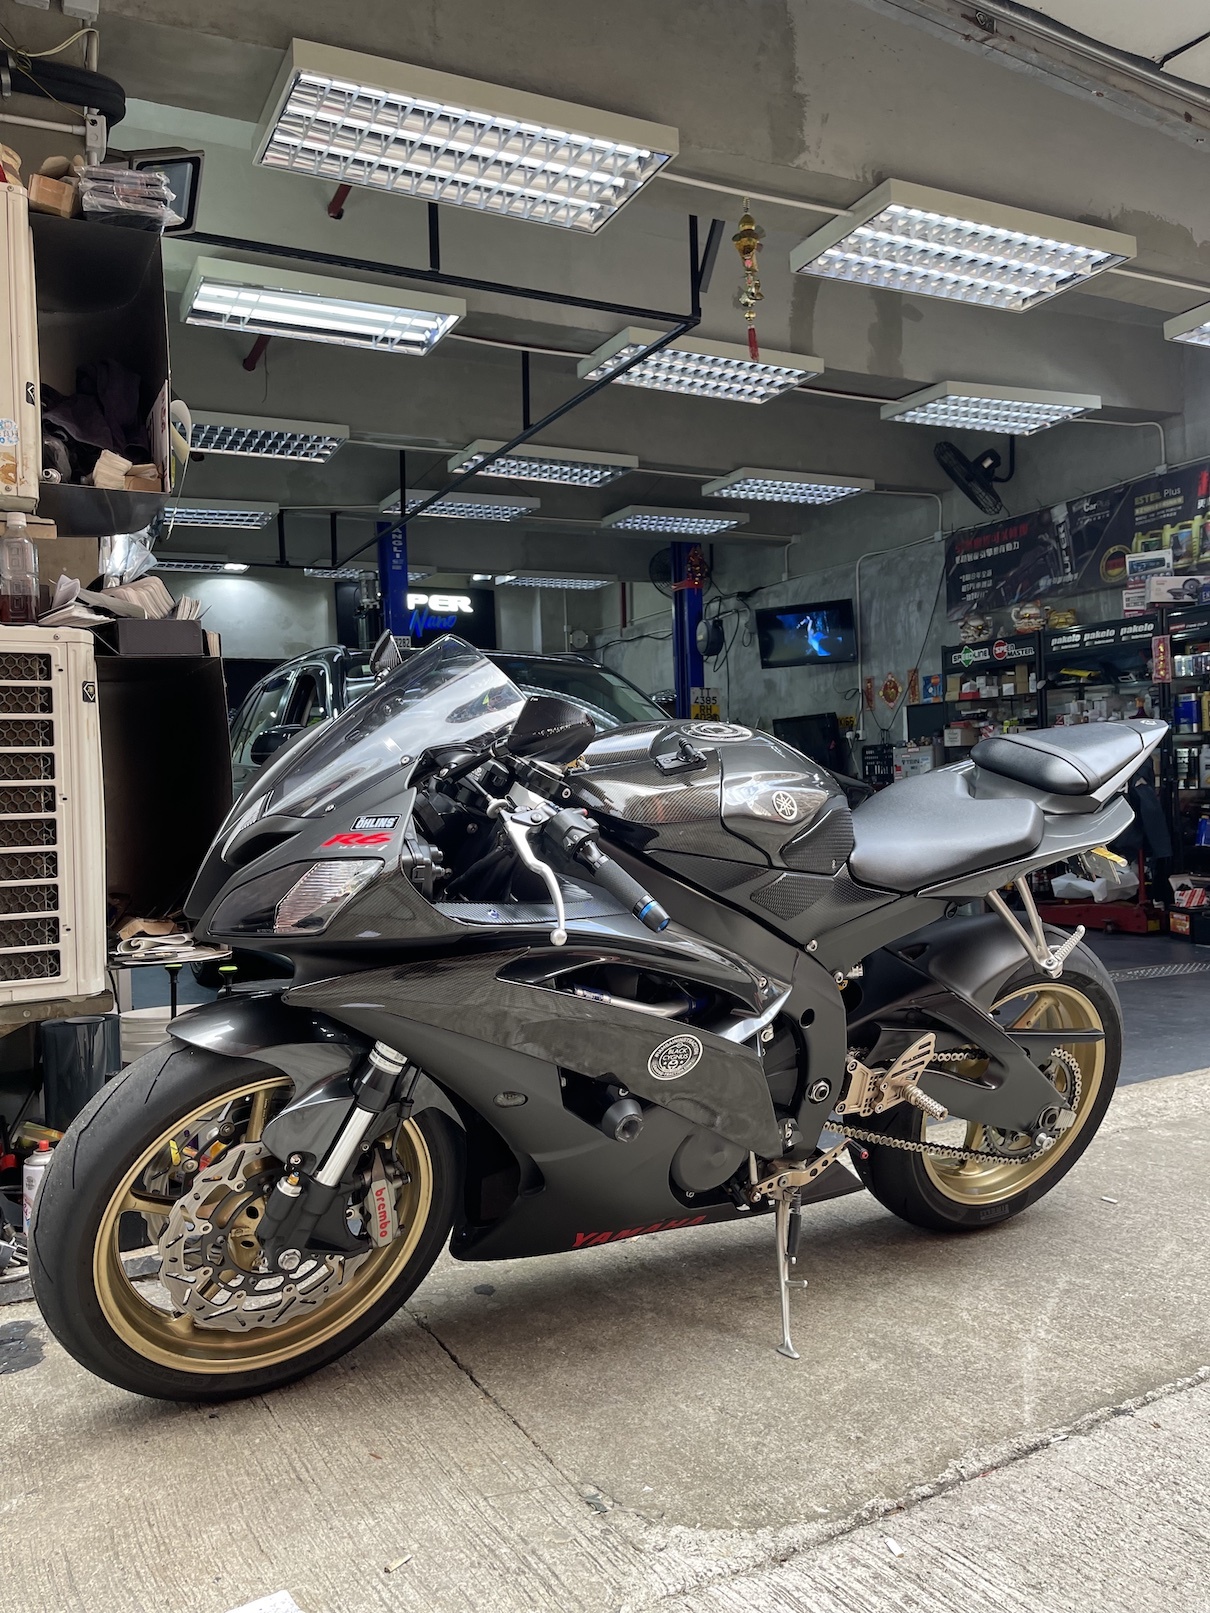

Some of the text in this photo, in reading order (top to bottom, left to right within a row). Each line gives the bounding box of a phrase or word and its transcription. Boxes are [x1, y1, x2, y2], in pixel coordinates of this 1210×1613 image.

[1163, 487, 1181, 498] Plus
[406, 593, 474, 613] PER
[408, 607, 458, 638] Nano
[1120, 622, 1155, 637] pakelo
[1050, 633, 1081, 647] pakelo
[1083, 628, 1116, 642] pakelo
[1007, 647, 1034, 657] MASTER
[693, 696, 718, 705] 4385
[699, 704, 713, 714] RH
[355, 816, 395, 829] ÖHLINS
[321, 831, 396, 848] R6
[667, 1047, 688, 1055] BLACK
[375, 1186, 391, 1238] brembo
[571, 1214, 707, 1248] YAMAHA
